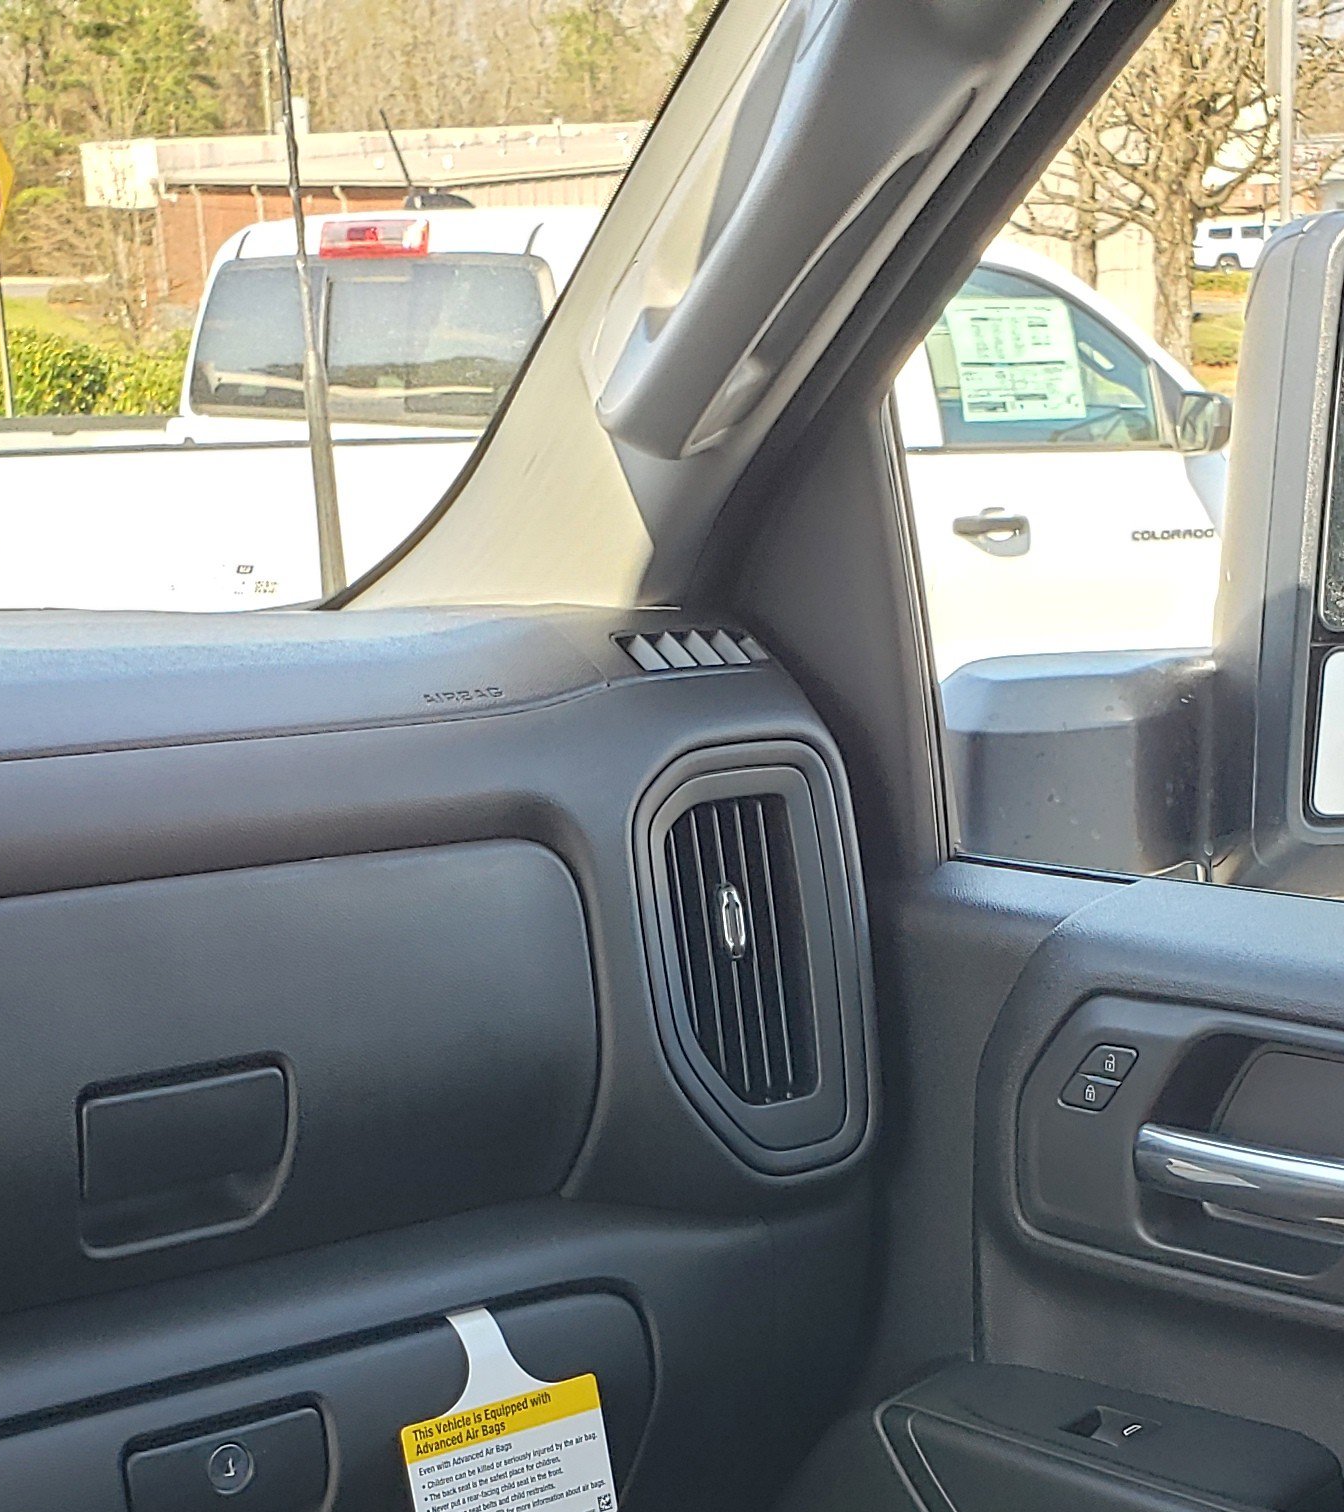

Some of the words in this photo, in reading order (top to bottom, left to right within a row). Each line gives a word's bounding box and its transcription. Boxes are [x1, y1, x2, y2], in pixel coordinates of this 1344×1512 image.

[1131, 528, 1215, 541] COLORADO
[412, 1426, 434, 1441] This
[434, 1415, 471, 1434] Vehicle
[483, 1397, 528, 1420] Equipped
[529, 1391, 551, 1407] with
[415, 1431, 463, 1456] Advanced
[465, 1427, 479, 1441] Air
[480, 1421, 505, 1436] Bags
[418, 1465, 435, 1476] Even
[436, 1460, 451, 1470] with
[452, 1449, 484, 1466] Advanced
[485, 1446, 493, 1456] Air
[495, 1442, 512, 1453] Bags
